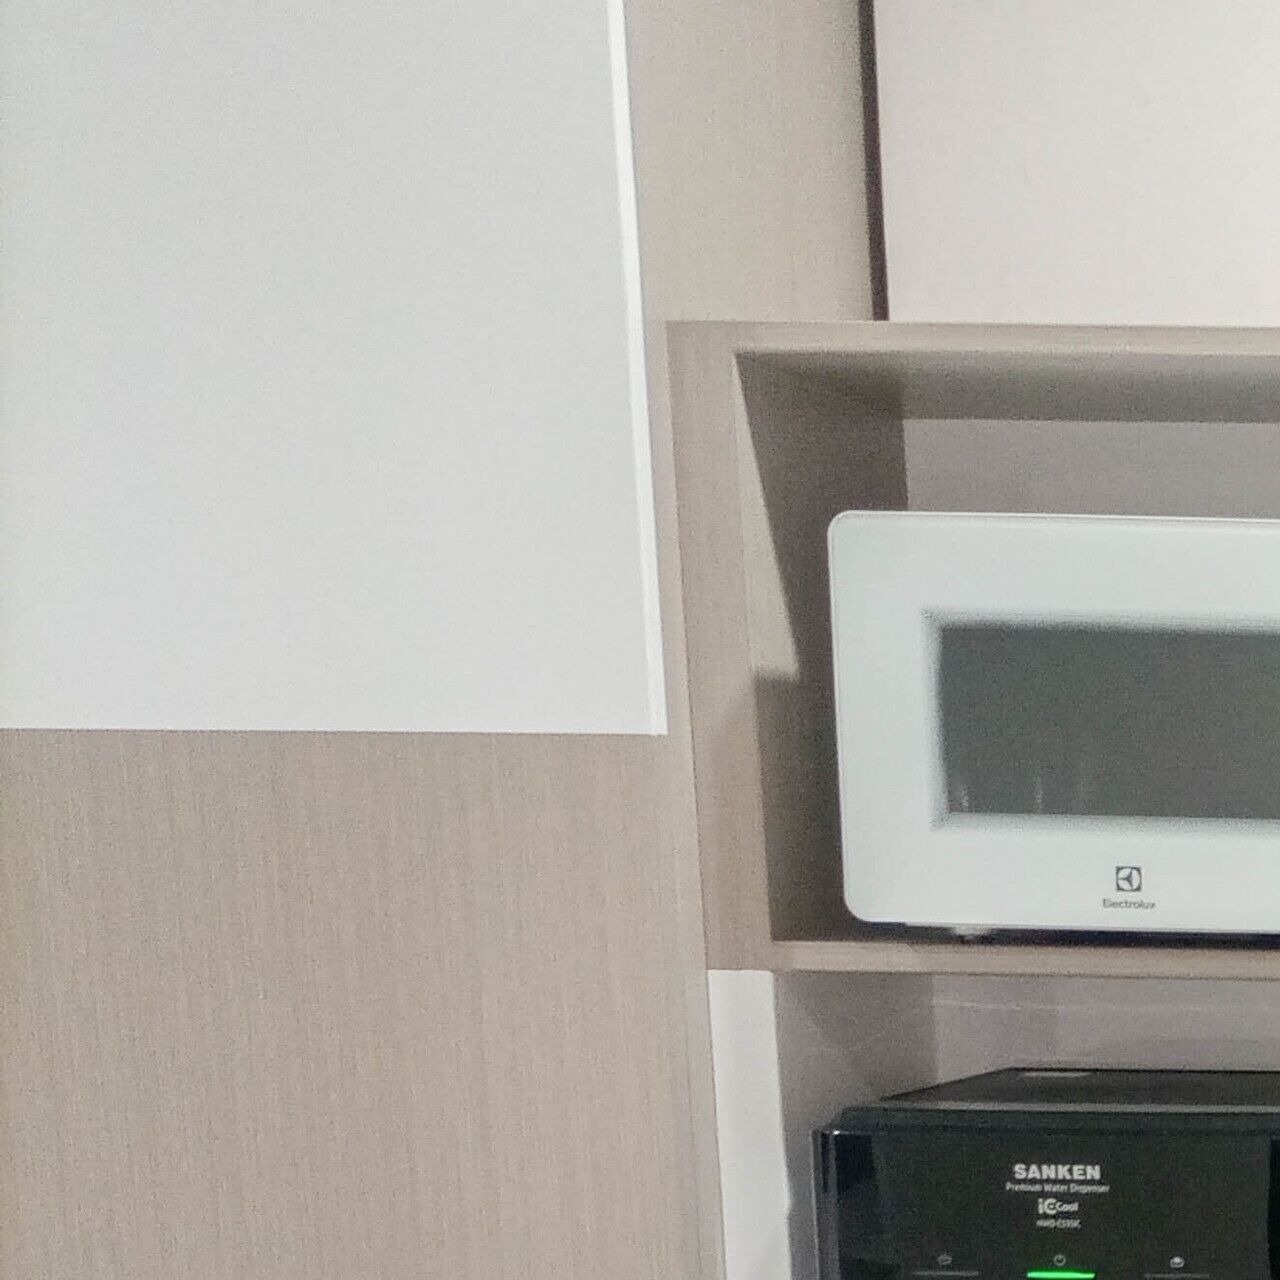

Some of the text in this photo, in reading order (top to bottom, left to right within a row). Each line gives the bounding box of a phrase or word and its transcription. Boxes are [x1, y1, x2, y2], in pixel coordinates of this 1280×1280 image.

[1013, 1163, 1101, 1180] SANKEN
[1005, 1181, 1043, 1192] Premium
[1043, 1183, 1068, 1193] Water
